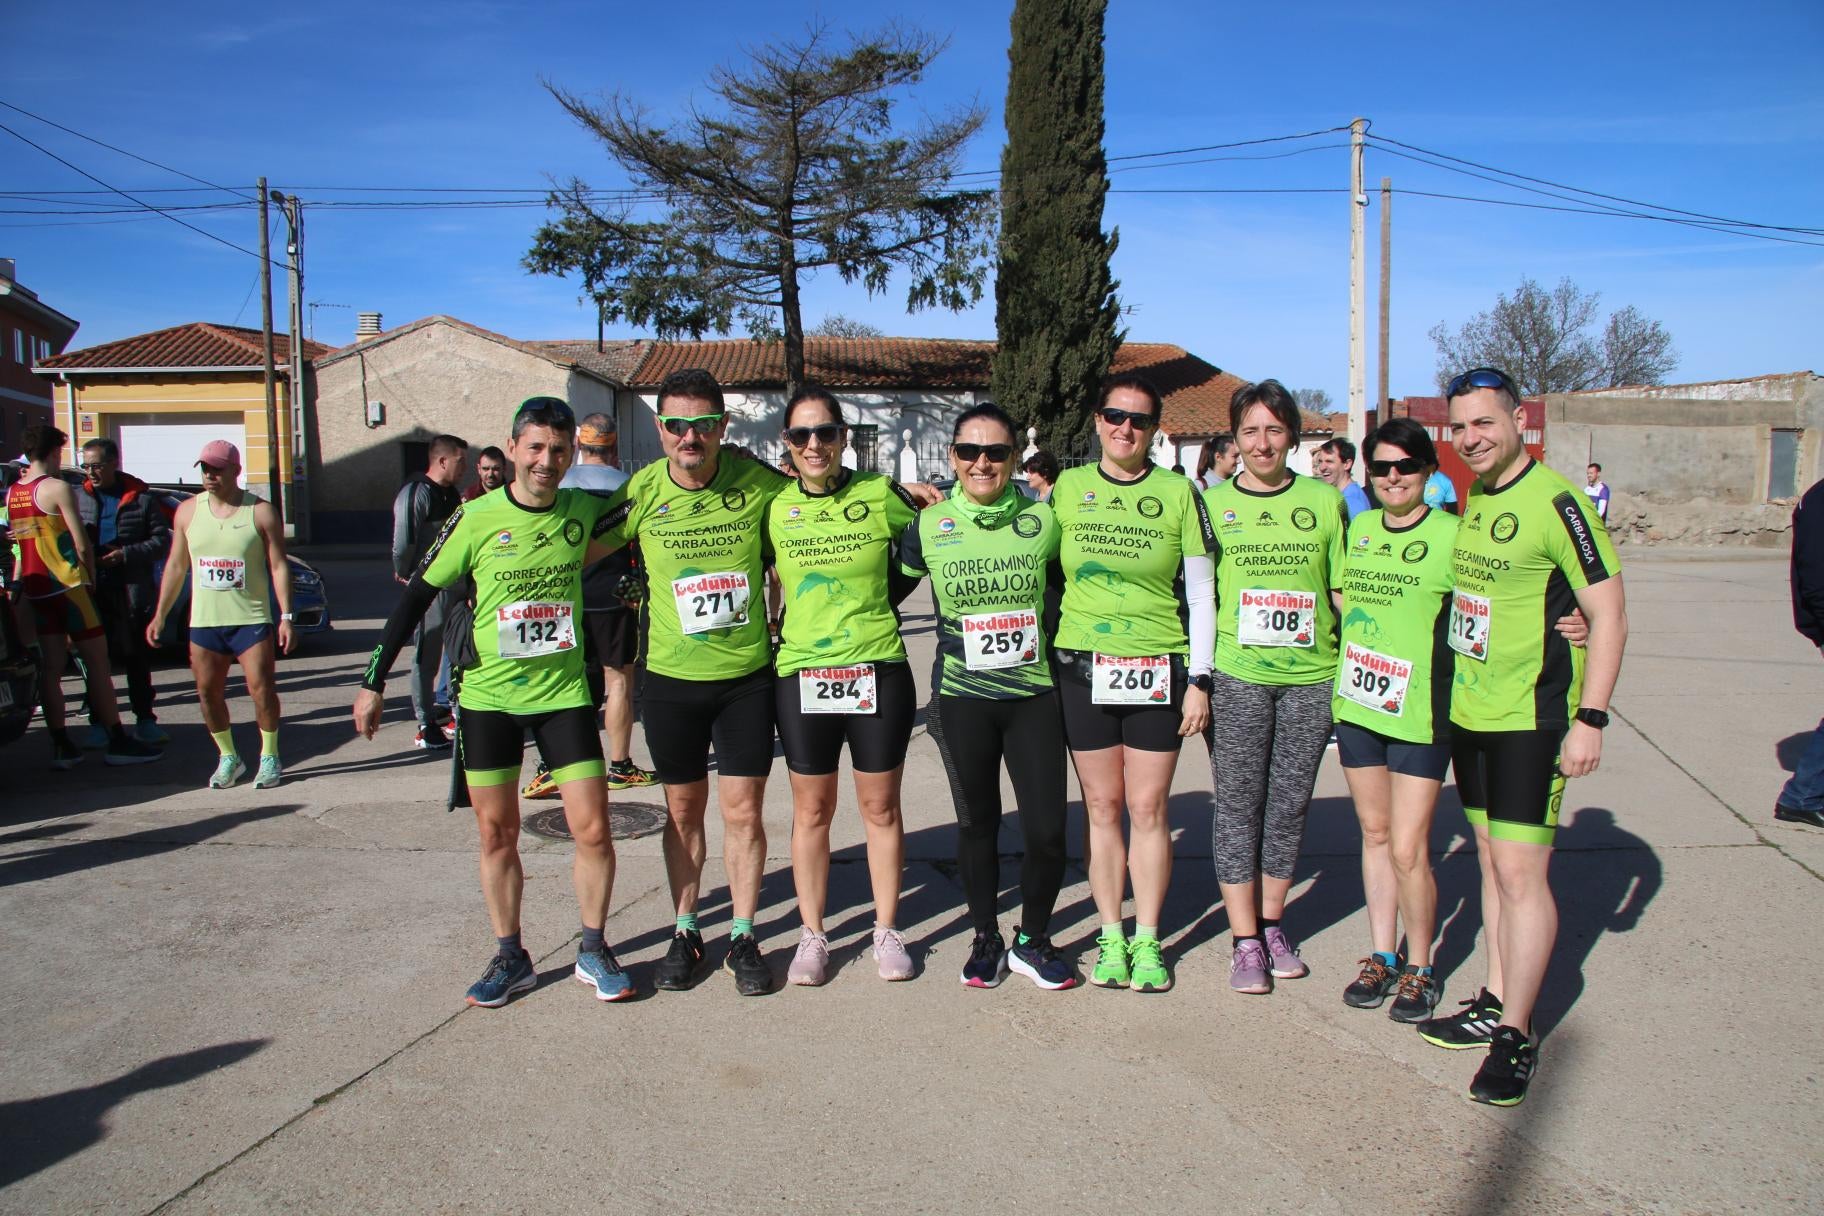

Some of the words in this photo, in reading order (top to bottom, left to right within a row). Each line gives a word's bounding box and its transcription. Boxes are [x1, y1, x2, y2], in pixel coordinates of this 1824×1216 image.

[1069, 522, 1164, 540] CORRECAMINOS
[1564, 506, 1596, 565] CARBAJOSA
[663, 535, 743, 549] CARBAJOSA
[780, 532, 873, 549] CORRECAMINOS
[1074, 533, 1152, 550] CARBAJOSA
[675, 549, 733, 560] SALAMANCA
[788, 543, 862, 559] CARBAJOSA
[1081, 545, 1140, 560] SALAMANCA
[1224, 543, 1320, 556] CORRECAMINOS
[800, 555, 853, 568] SALAMANCA
[942, 554, 1040, 579] CORRECAMINOS
[1235, 555, 1310, 567] CARBAJOSA
[208, 569, 235, 581] 198
[1246, 568, 1299, 577] SALAMANCA
[945, 573, 1039, 598] CARBAJOSA
[1343, 580, 1404, 597] CARBAJOSA
[692, 591, 734, 617] 271
[953, 594, 1035, 609] SALAMANCA
[1242, 592, 1313, 609] bedunia
[1349, 594, 1393, 607] SALAMANCA
[964, 613, 1035, 633] bedunia
[1256, 609, 1300, 632] 308
[1452, 611, 1476, 641] 212
[516, 620, 558, 644] 132
[980, 630, 1024, 655] 259
[1346, 645, 1409, 679] bedunia
[1109, 669, 1154, 690] 260
[1352, 666, 1390, 697] 309
[816, 681, 861, 699] 284
